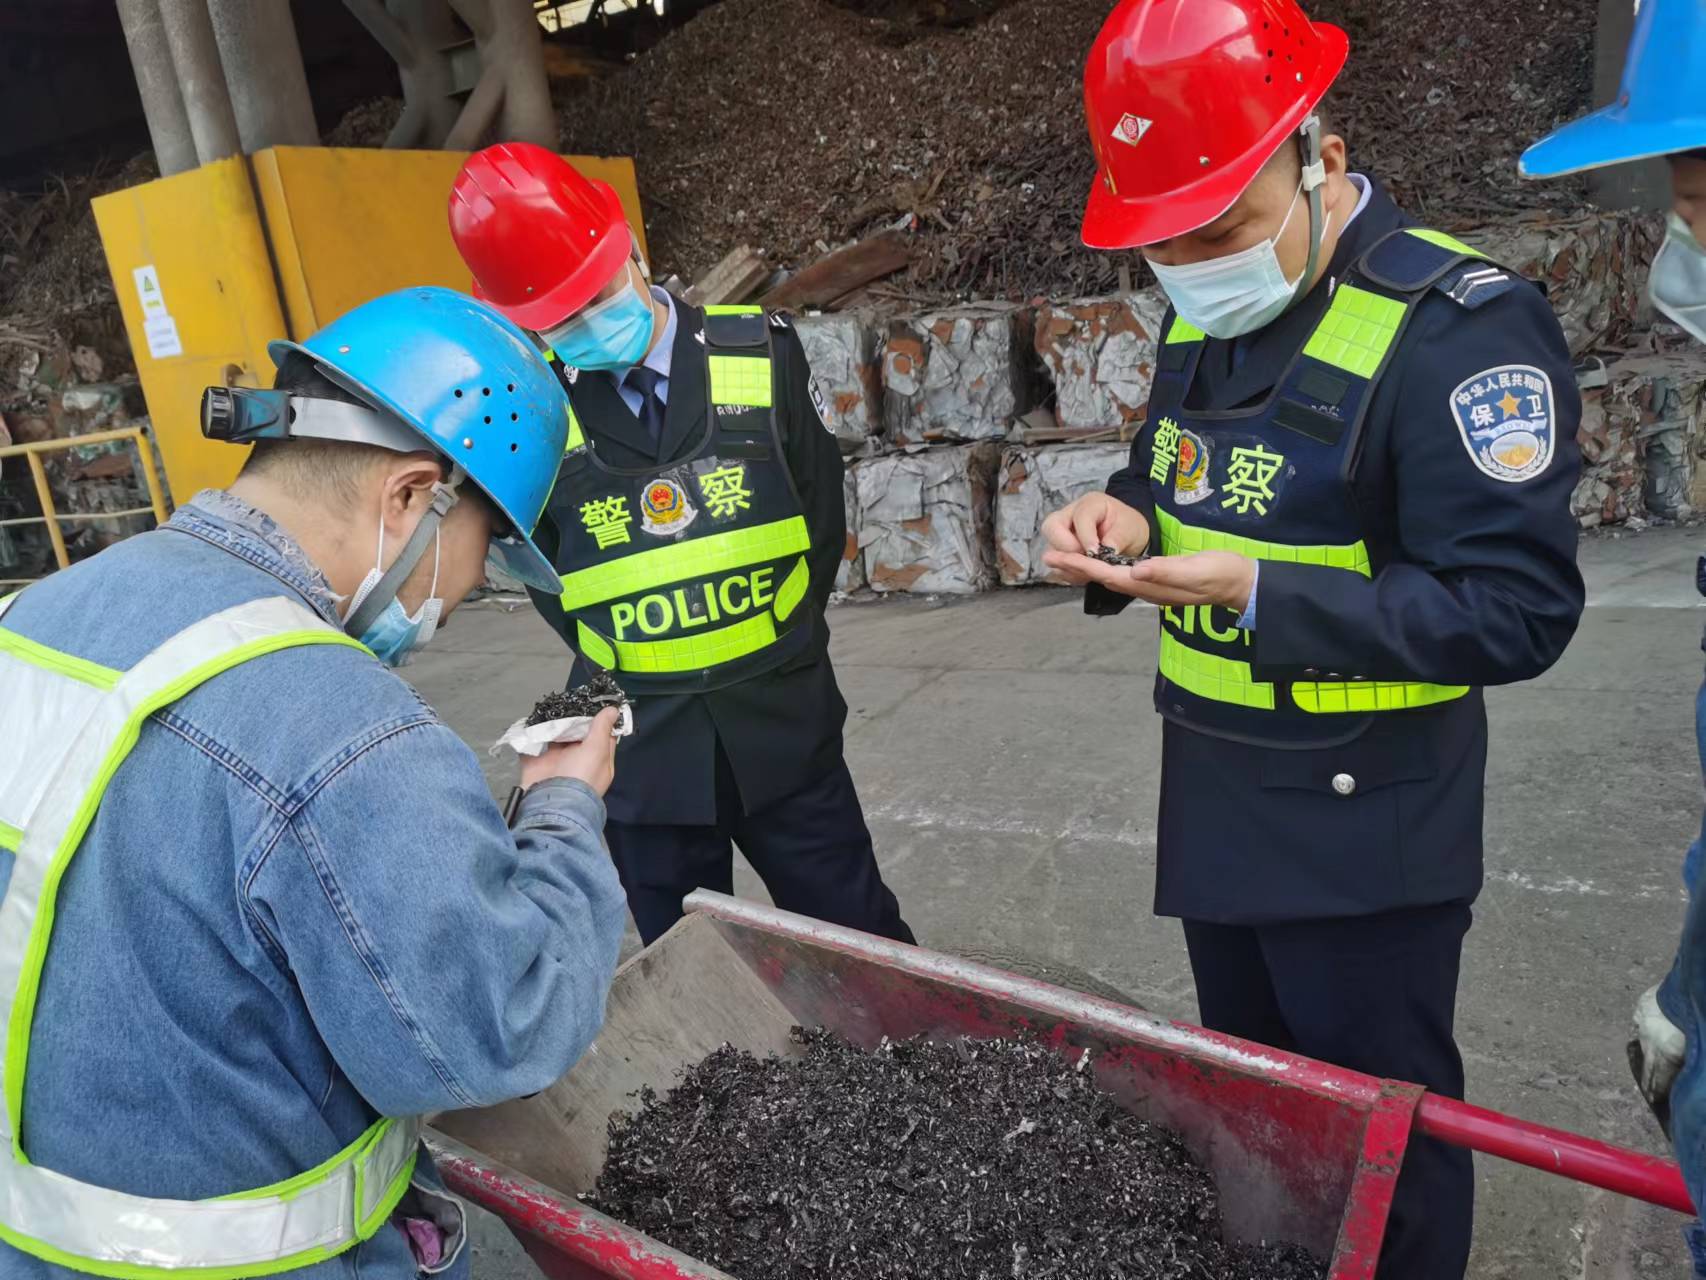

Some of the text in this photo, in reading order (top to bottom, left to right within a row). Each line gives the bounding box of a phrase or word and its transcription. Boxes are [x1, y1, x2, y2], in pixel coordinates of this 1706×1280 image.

[1469, 403, 1496, 429] 保
[1525, 394, 1546, 418] 卫
[1149, 416, 1285, 517] 警 察
[579, 494, 633, 550] 警
[698, 466, 752, 519] 察
[610, 566, 776, 641] POLICE
